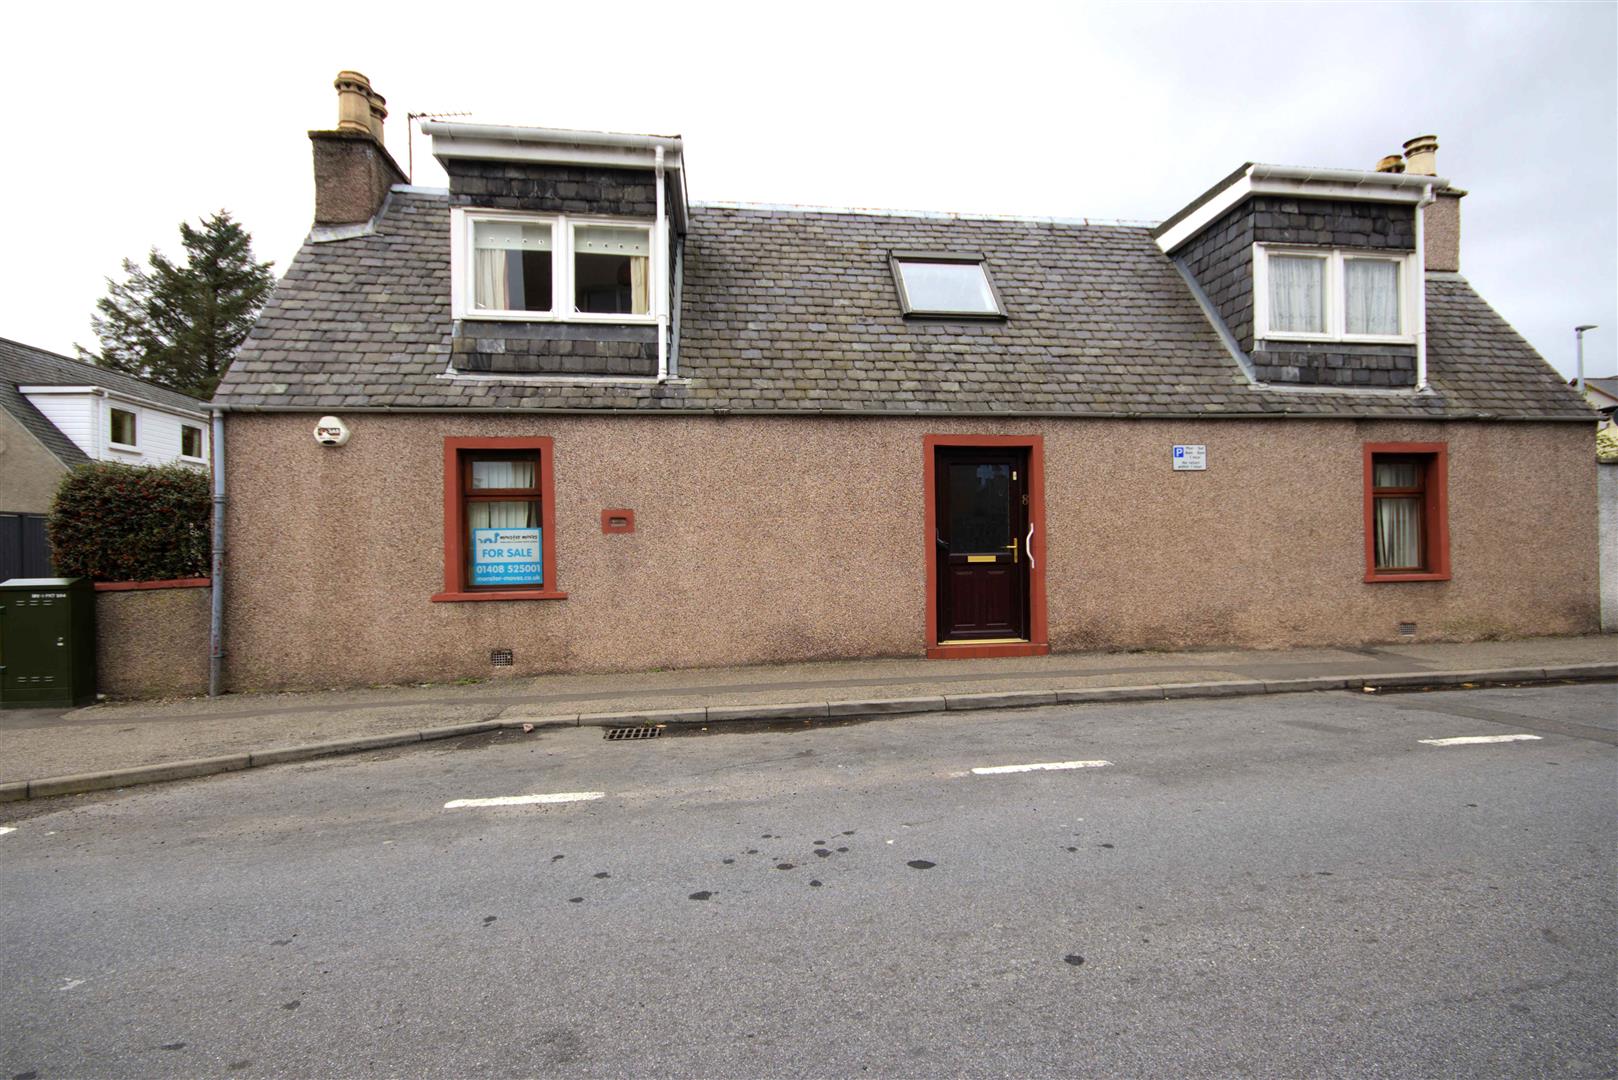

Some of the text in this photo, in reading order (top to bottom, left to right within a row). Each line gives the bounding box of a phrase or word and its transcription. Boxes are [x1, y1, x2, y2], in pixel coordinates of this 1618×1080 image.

[482, 548, 533, 557] FOR SALE
[476, 564, 541, 573] 01408 525001
